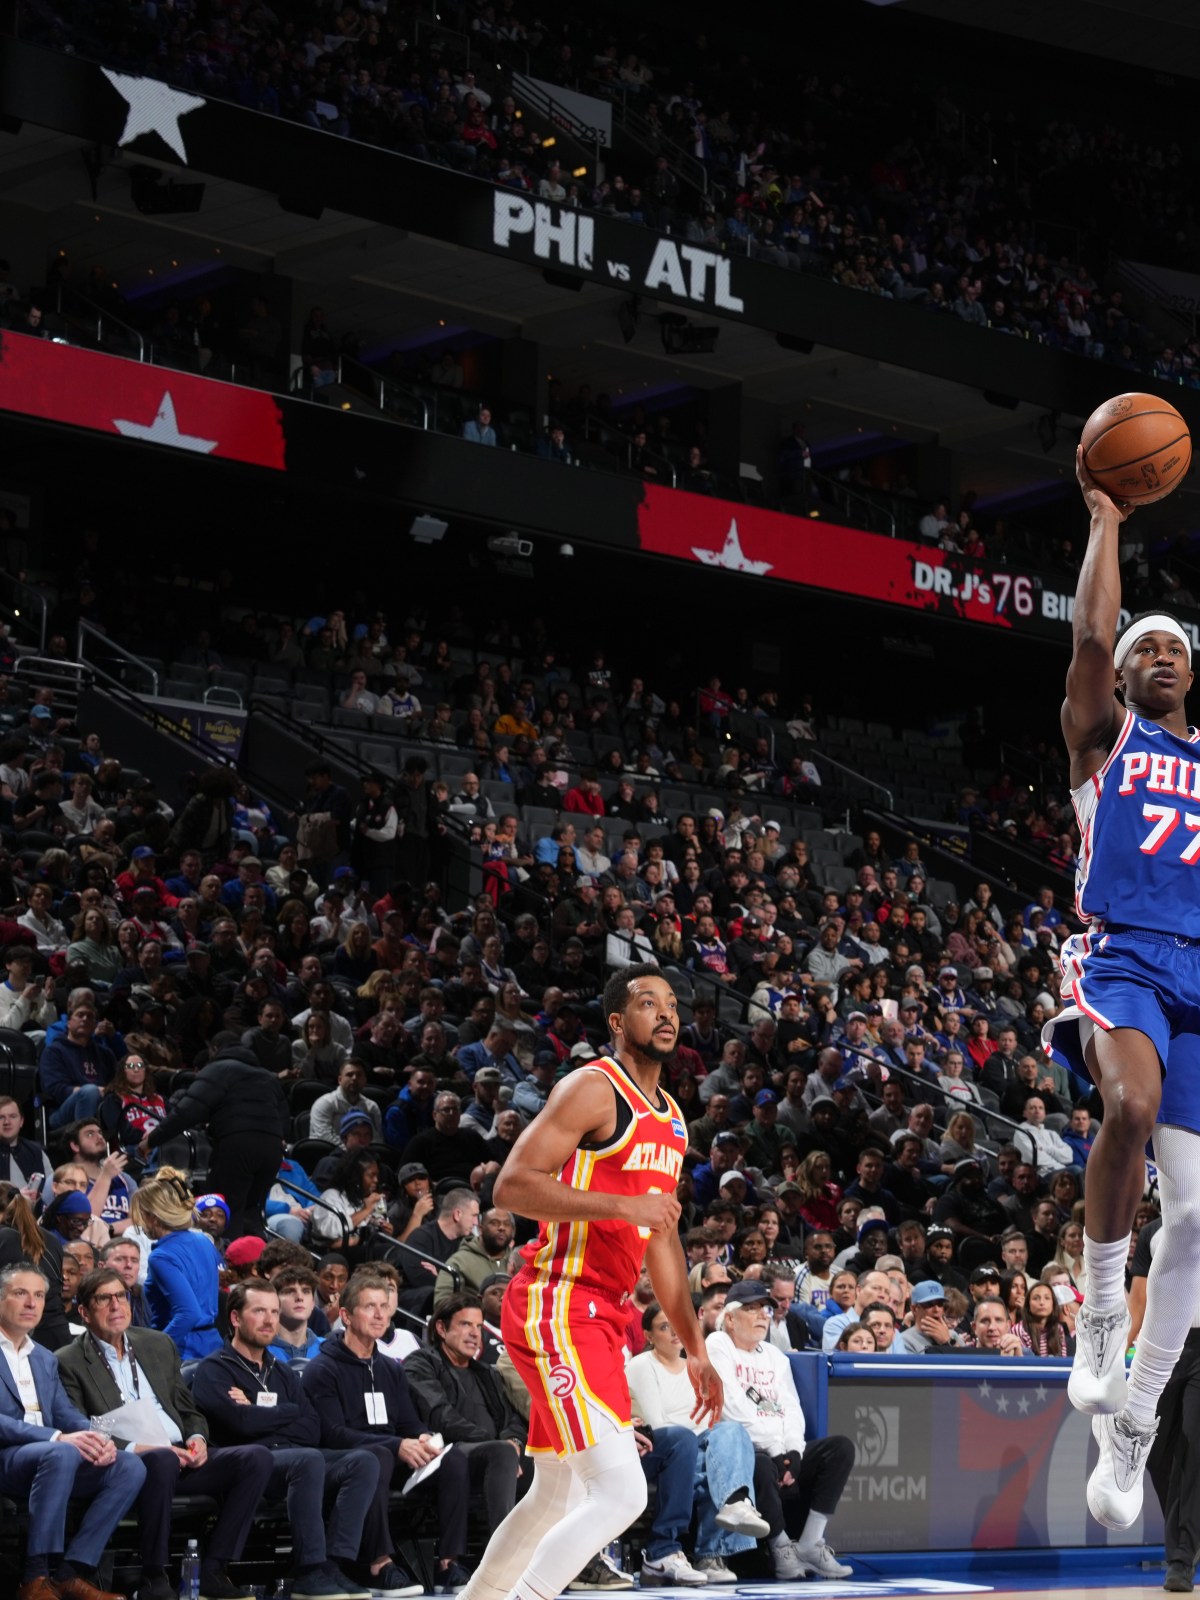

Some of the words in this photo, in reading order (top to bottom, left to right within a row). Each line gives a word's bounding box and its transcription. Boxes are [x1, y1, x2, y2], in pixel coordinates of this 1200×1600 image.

[493, 189, 595, 271] PHI
[606, 259, 632, 282] vs
[644, 237, 744, 314] ATL
[992, 573, 1034, 616] 76
[621, 1142, 685, 1184] ATLANT
[840, 1475, 927, 1501] ETMGM
